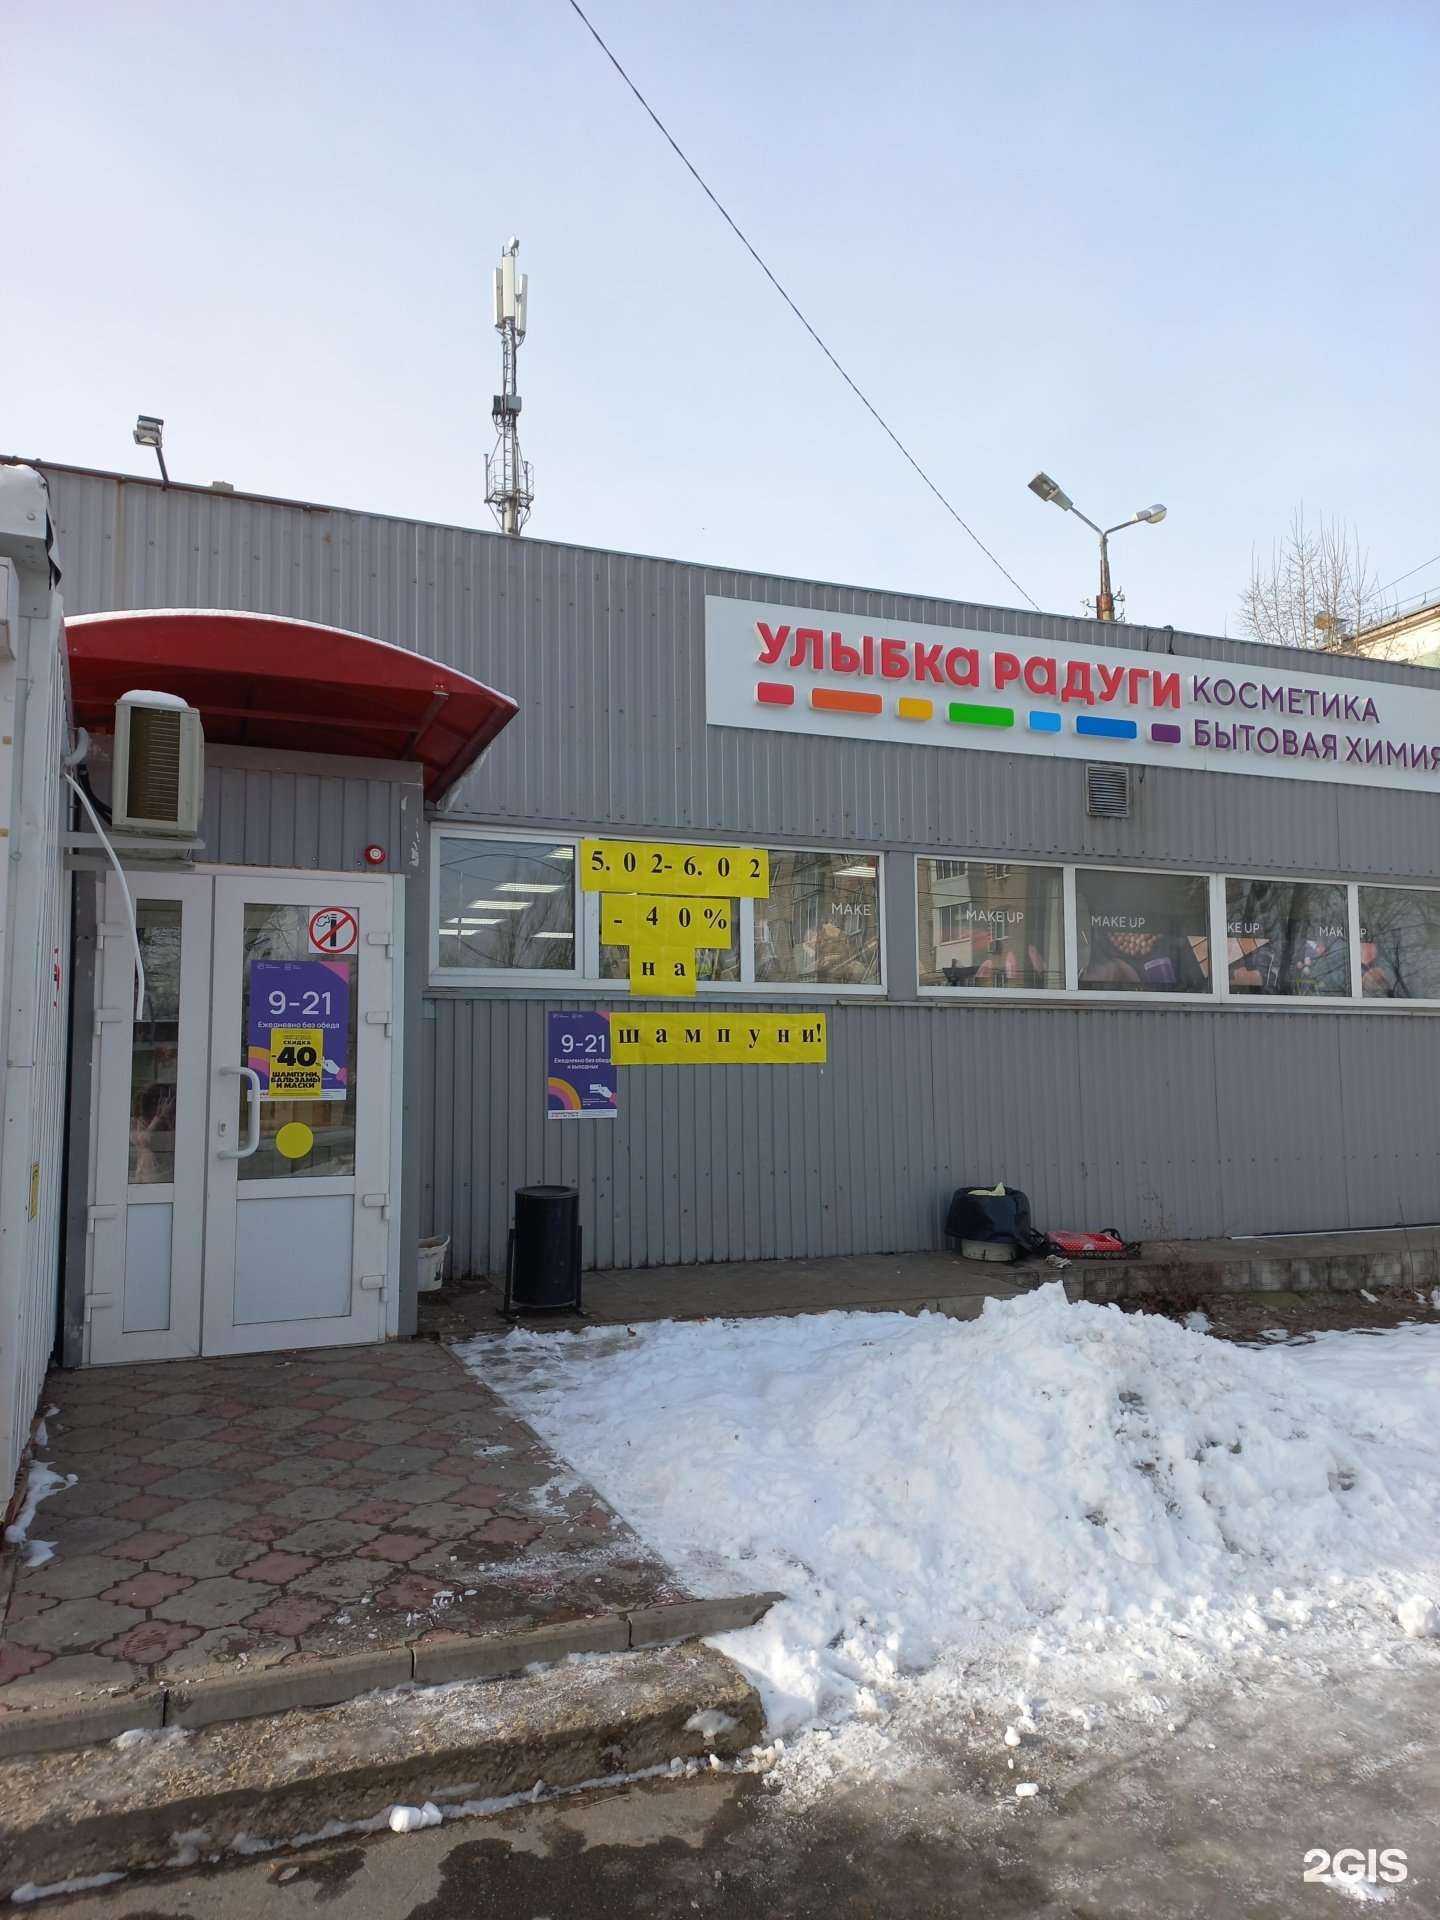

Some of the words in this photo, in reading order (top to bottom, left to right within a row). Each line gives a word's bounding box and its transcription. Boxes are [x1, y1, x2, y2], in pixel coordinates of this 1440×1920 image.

[1193, 675, 1380, 724] КОСМЕТИКА
[1194, 719, 1338, 760] БЫТОВАЯ
[1345, 735, 1440, 770] ХИМИЯ
[831, 902, 872, 916] MAKE
[965, 909, 1004, 923] MAKE
[1006, 912, 1024, 923] UP
[1091, 915, 1126, 928] MAKE
[1129, 917, 1146, 928] UP
[1227, 922, 1242, 933] KE
[1244, 923, 1260, 933] UP
[1319, 926, 1344, 937] MAK
[641, 961, 686, 977] на
[268, 990, 331, 1015] 9-21
[561, 1034, 605, 1053] 9-21
[618, 1023, 823, 1048] шампуни!
